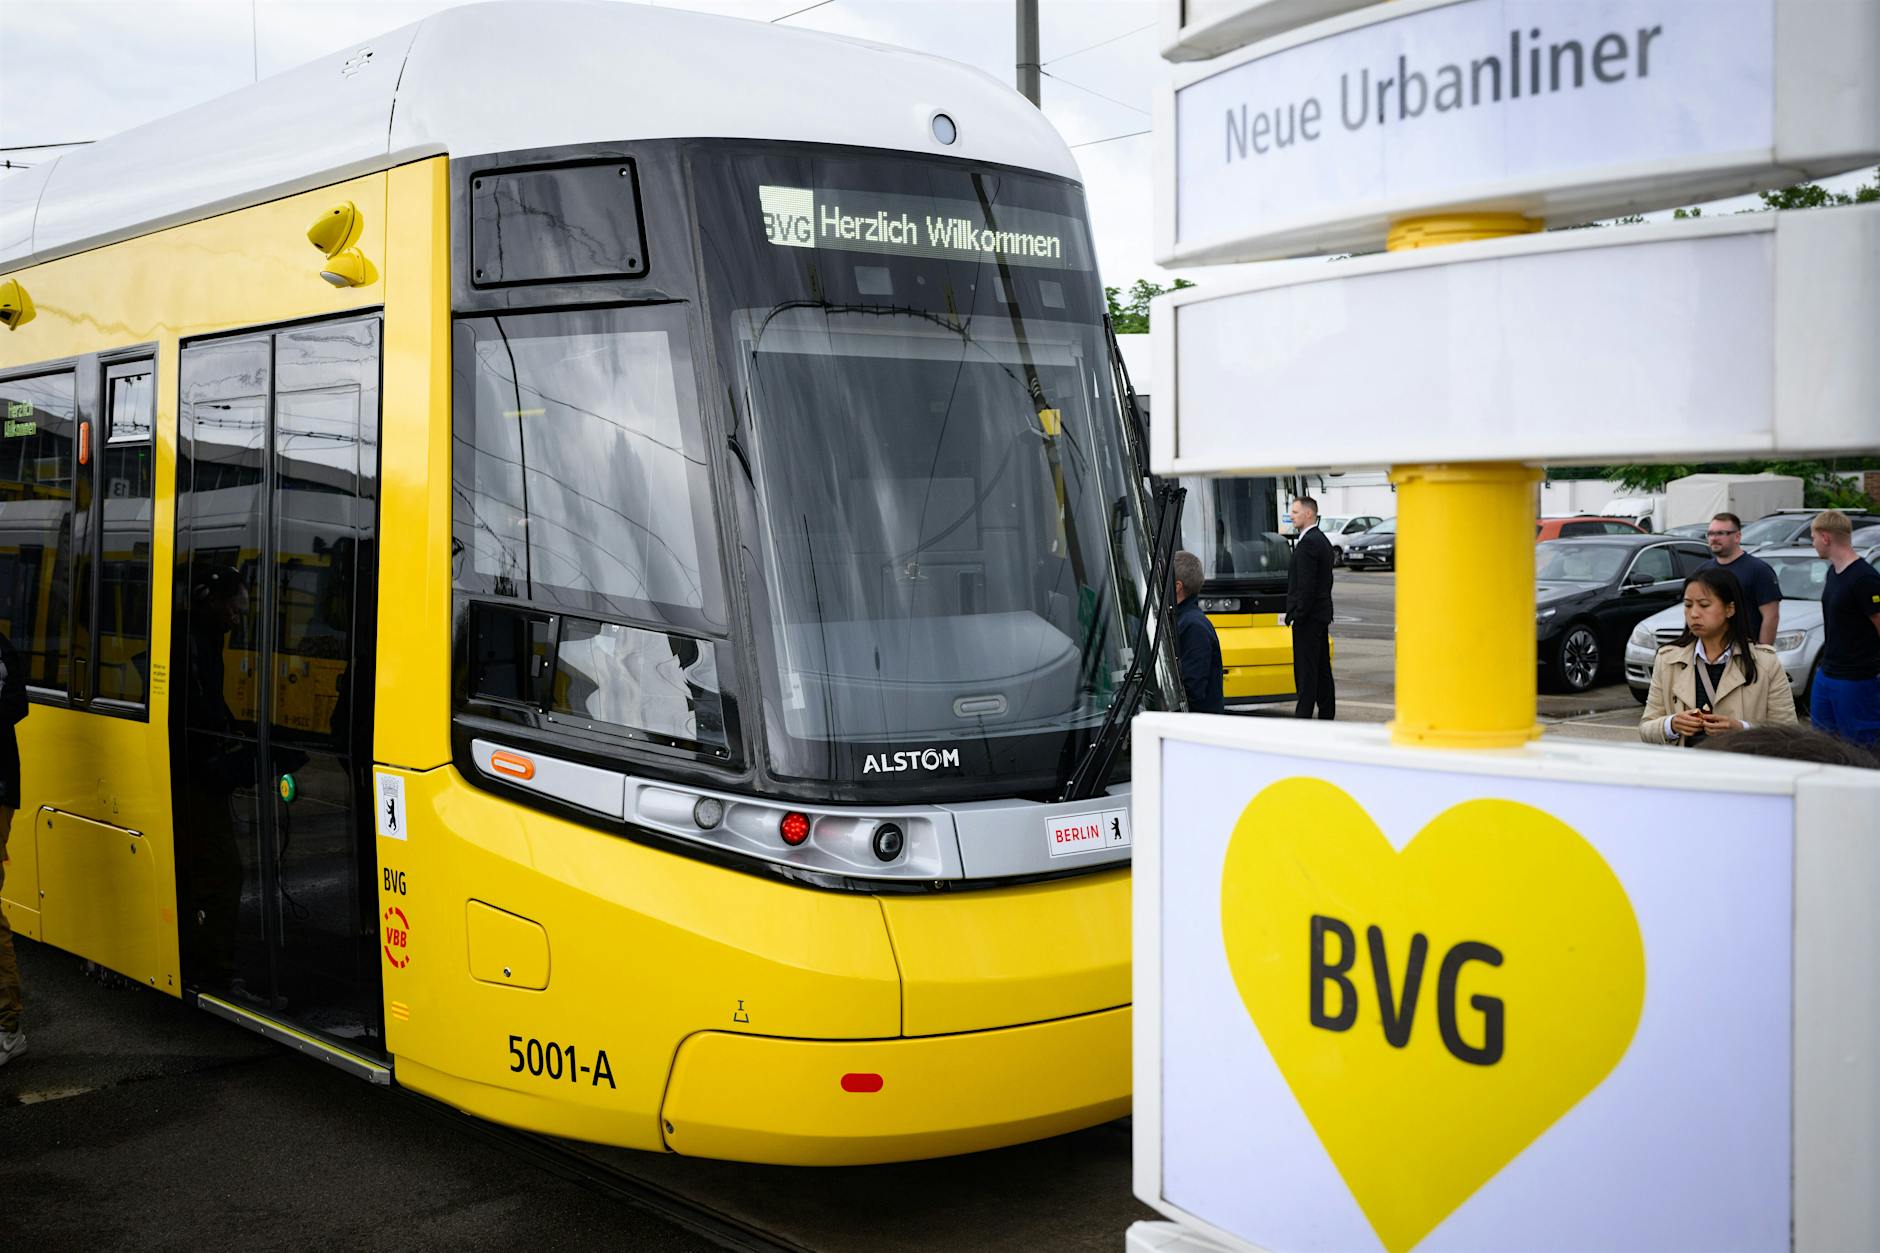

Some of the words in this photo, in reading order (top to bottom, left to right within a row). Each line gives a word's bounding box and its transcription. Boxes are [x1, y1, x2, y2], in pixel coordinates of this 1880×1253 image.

[1225, 97, 1322, 164] Neue
[1340, 25, 1663, 131] Urbanliner
[820, 205, 917, 245] Herzlich
[925, 216, 1061, 258] Willkommen
[862, 748, 960, 774] ALSTOM
[1055, 825, 1099, 843] BERLIN
[383, 867, 407, 896] BVG
[386, 926, 407, 948] VBB
[1310, 914, 1505, 1067] BVG
[508, 1034, 617, 1089] 5001-A
